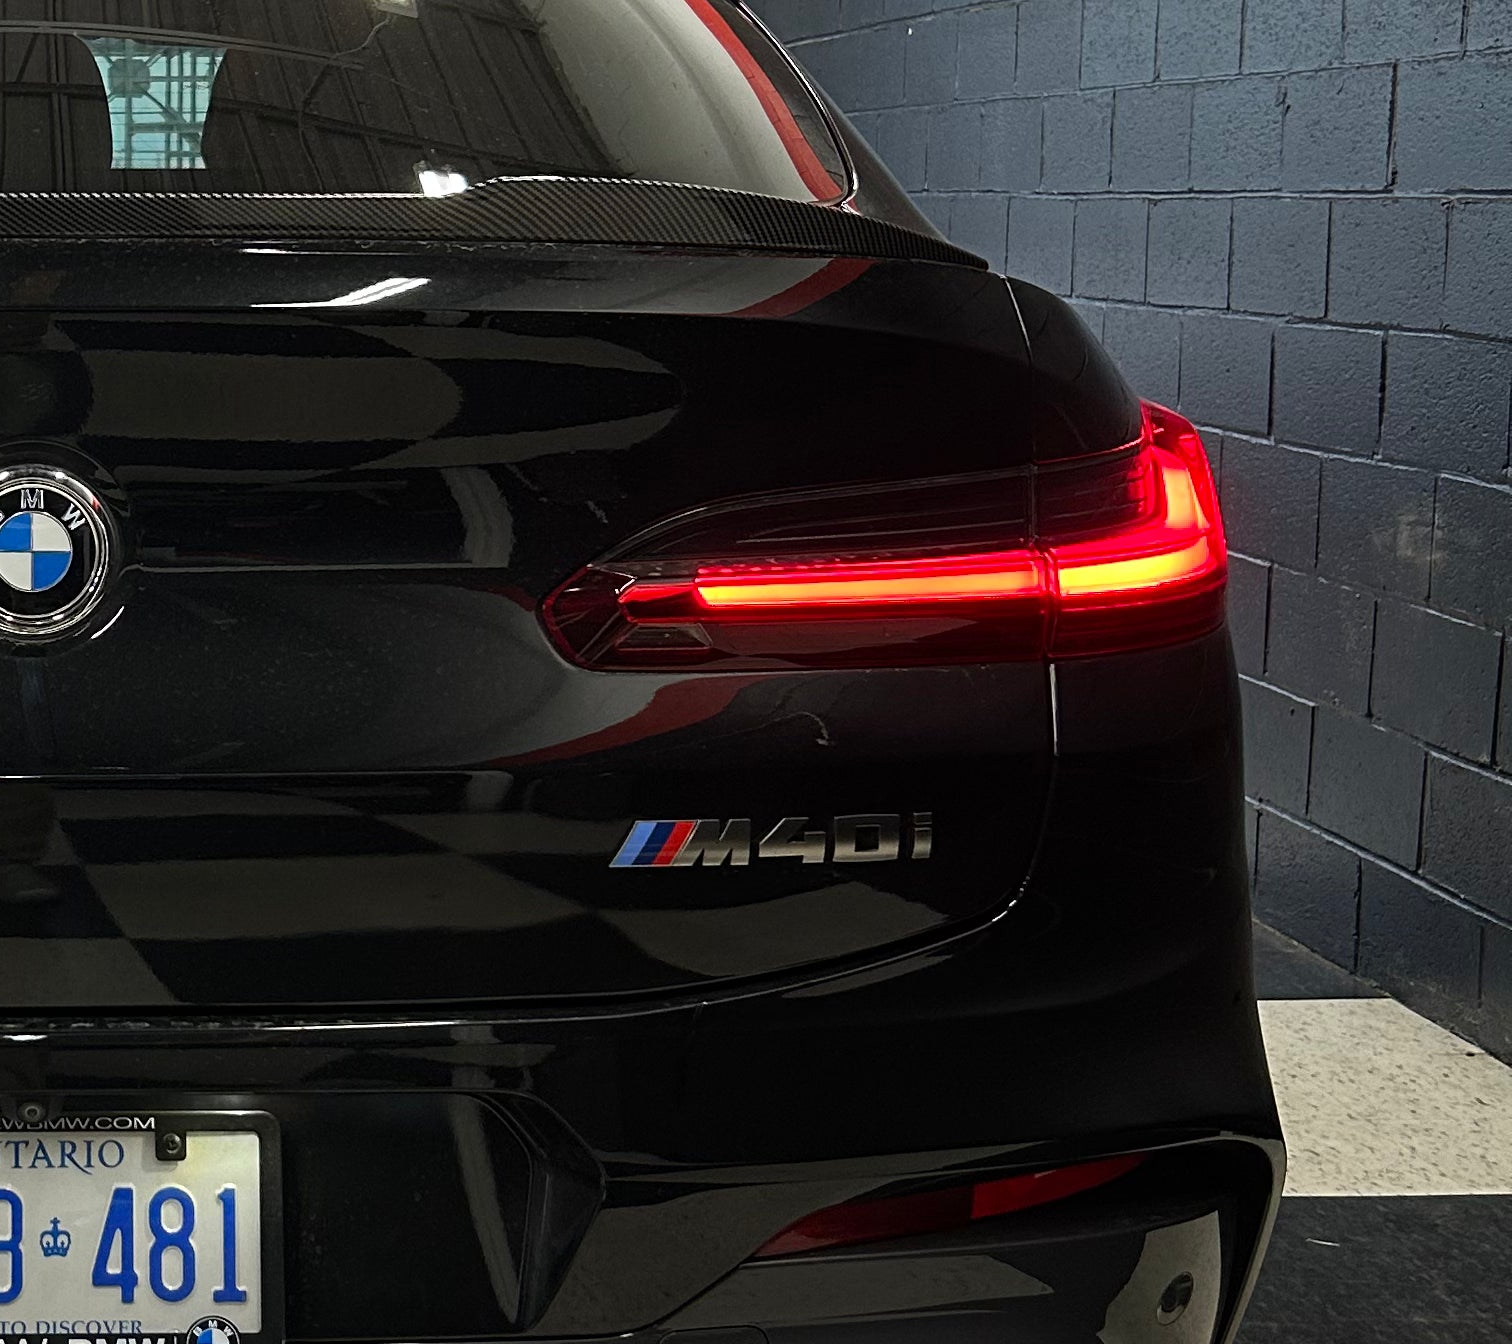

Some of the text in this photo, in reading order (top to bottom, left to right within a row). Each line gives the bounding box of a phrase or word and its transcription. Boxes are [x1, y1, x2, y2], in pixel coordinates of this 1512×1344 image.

[91, 1186, 247, 1304] 481
[35, 1320, 143, 1335] DISCOVER
[193, 1319, 234, 1337] BMW
